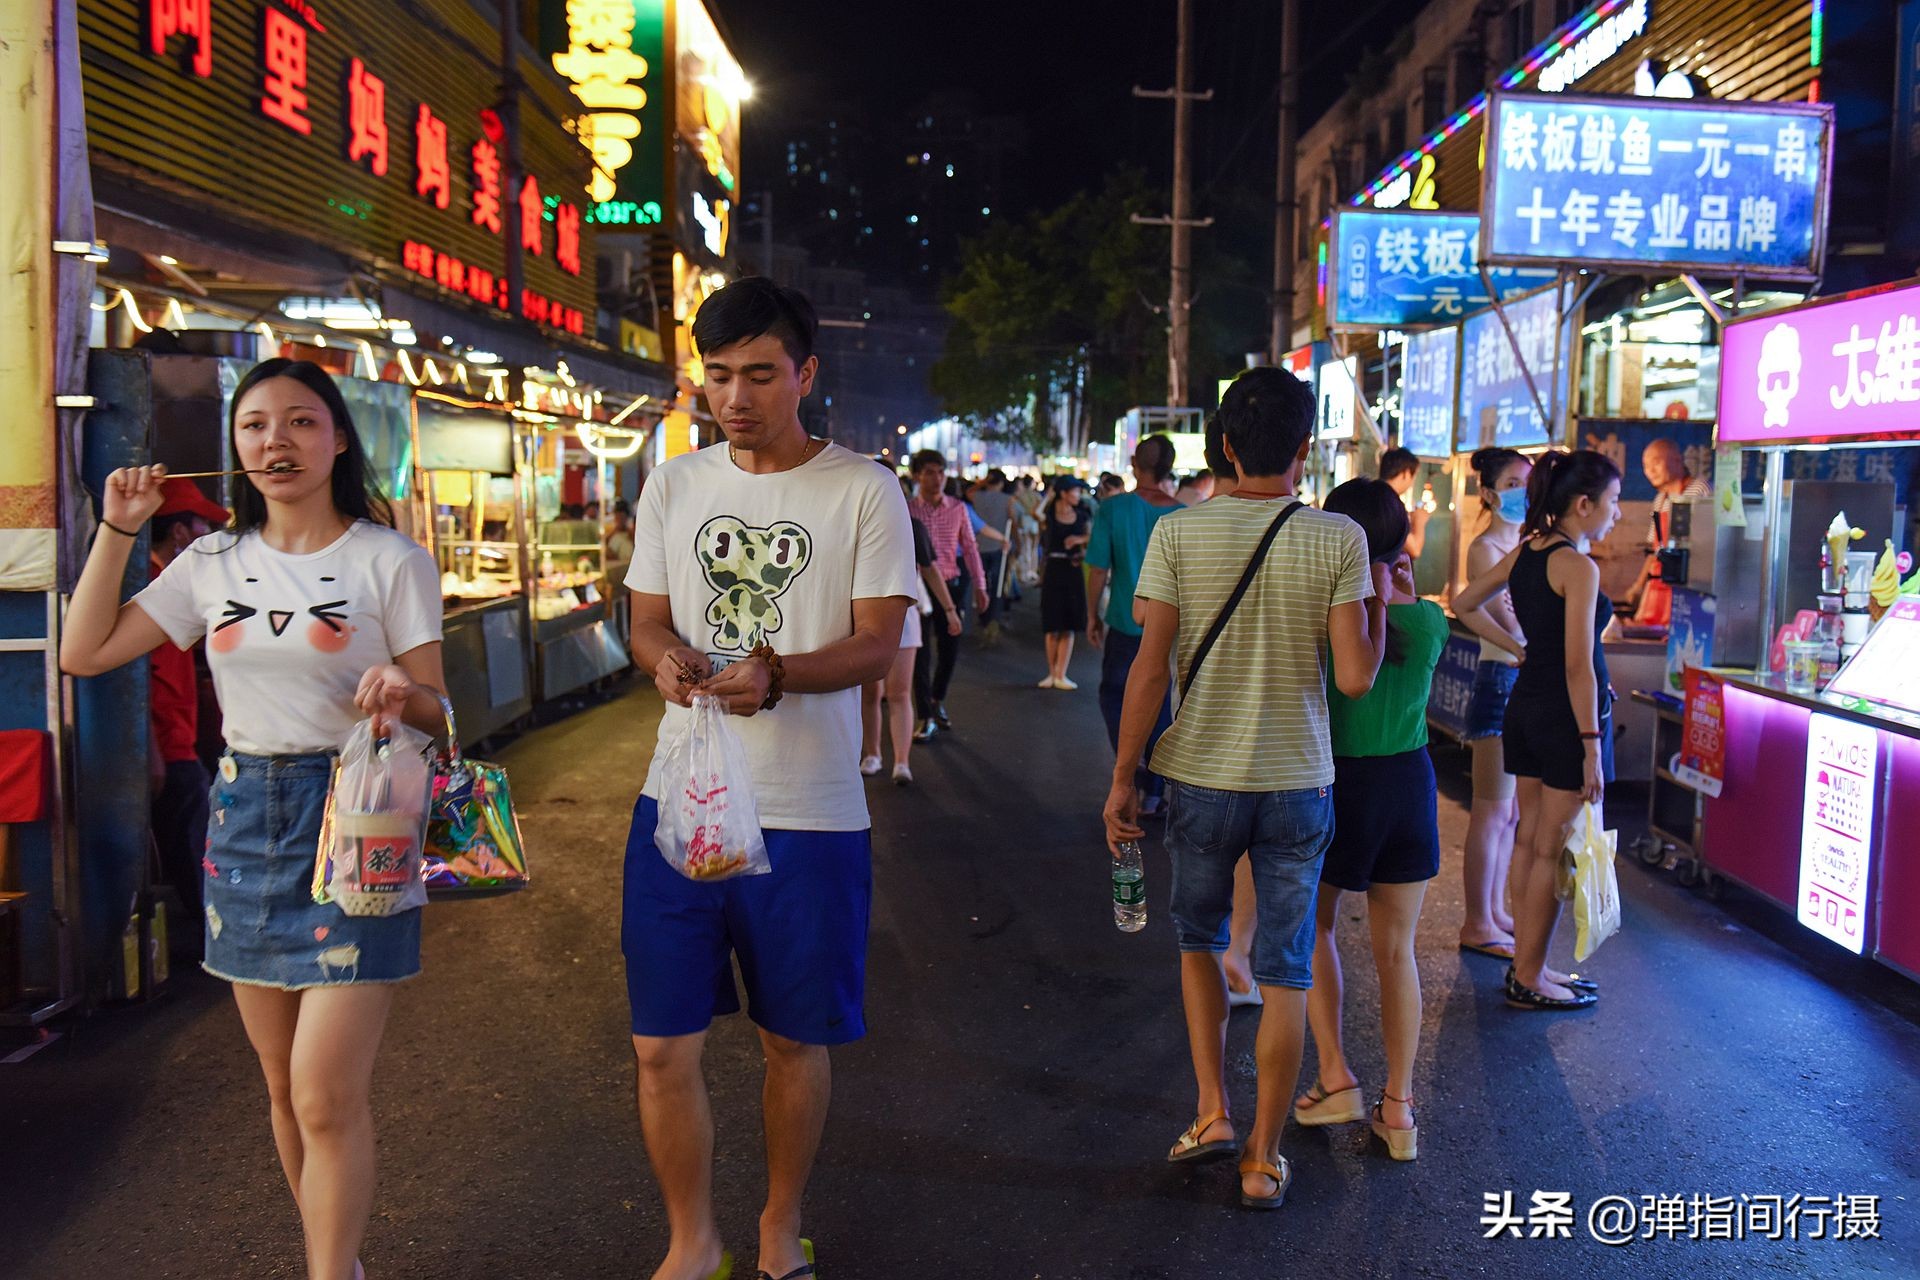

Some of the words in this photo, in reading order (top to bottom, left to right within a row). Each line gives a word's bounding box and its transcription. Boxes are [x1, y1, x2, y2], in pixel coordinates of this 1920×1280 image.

[1502, 112, 1807, 183] 铁板鱿鱼一元一串
[1516, 187, 1777, 252] 十年专业品牌
